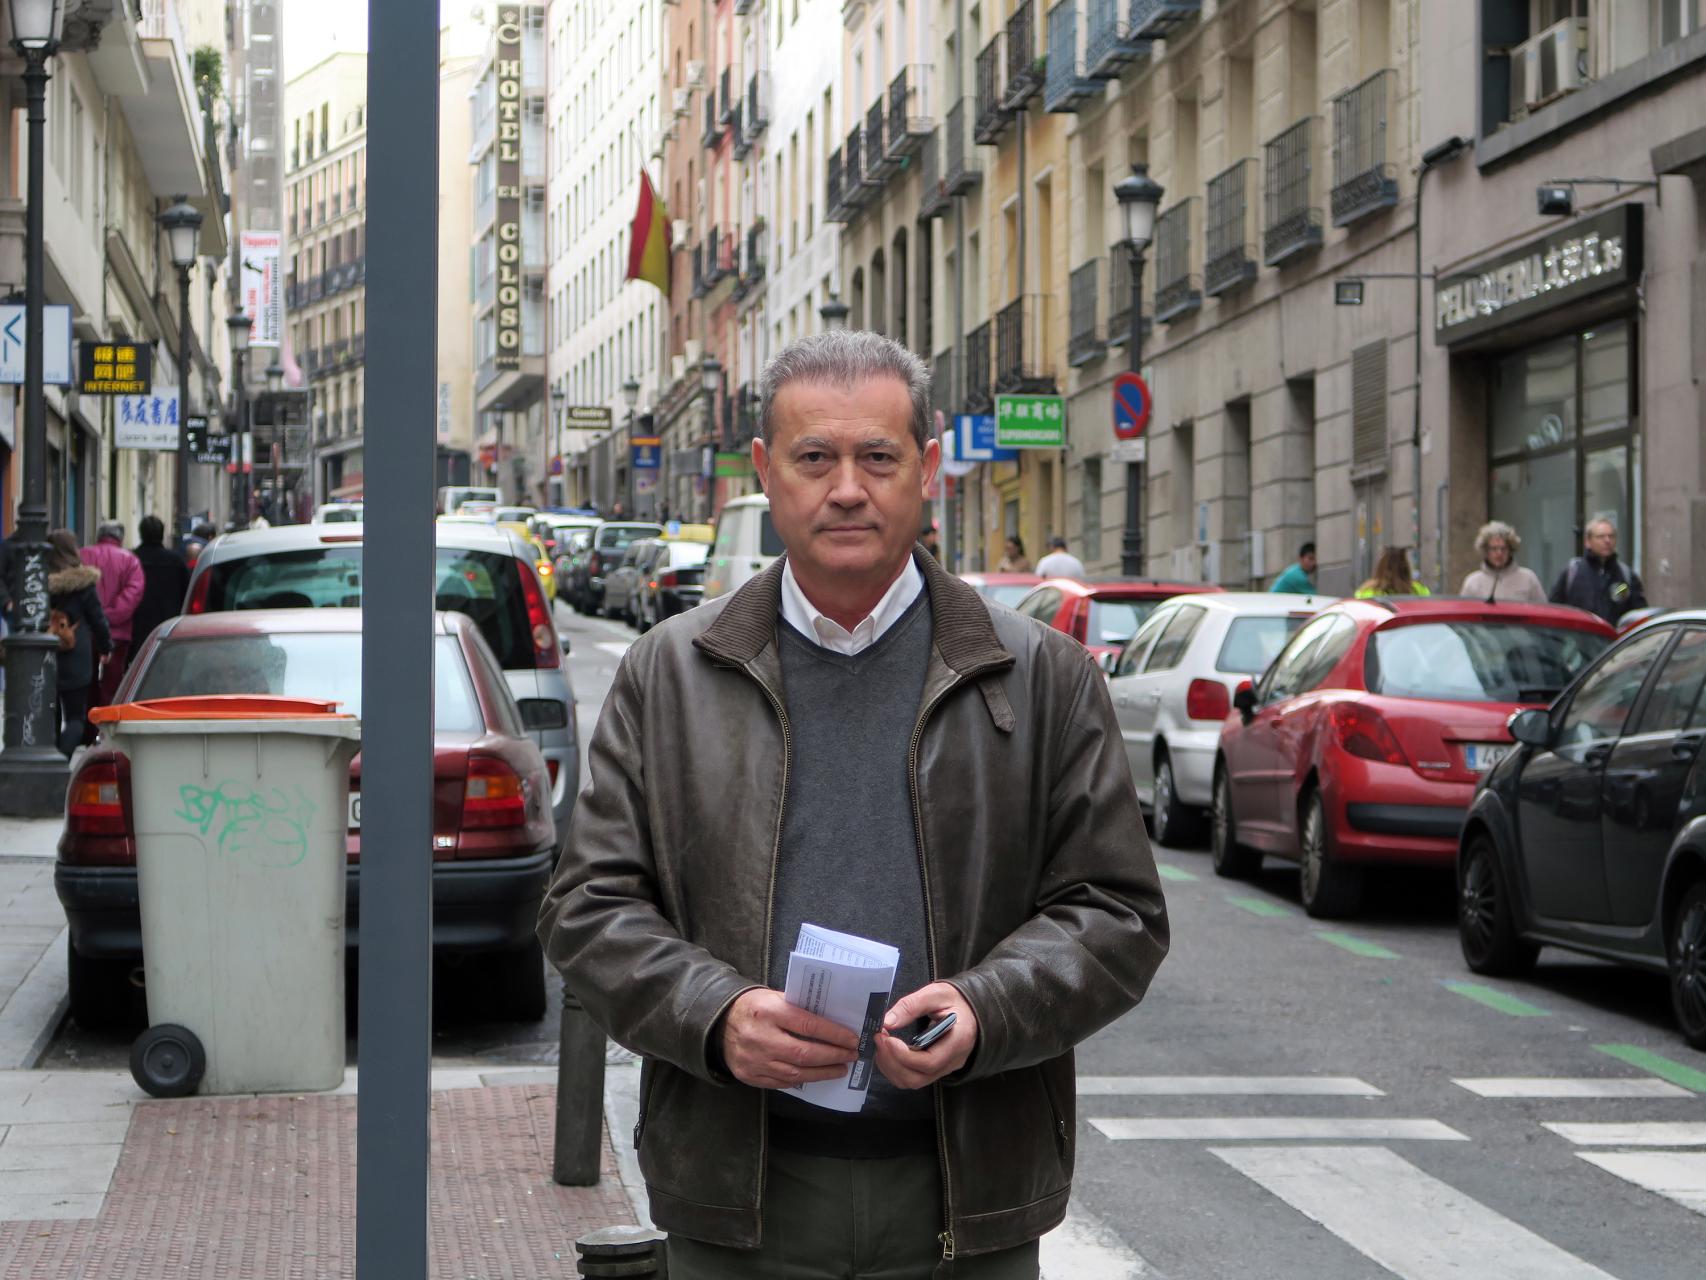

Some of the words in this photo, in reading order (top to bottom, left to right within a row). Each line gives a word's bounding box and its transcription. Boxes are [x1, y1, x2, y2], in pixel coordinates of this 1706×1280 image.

[500, 60, 519, 161] HOTEL
[498, 186, 519, 198] EL
[499, 223, 518, 348] COLOSO
[84, 381, 145, 392] INTERNET
[961, 416, 992, 459] L
